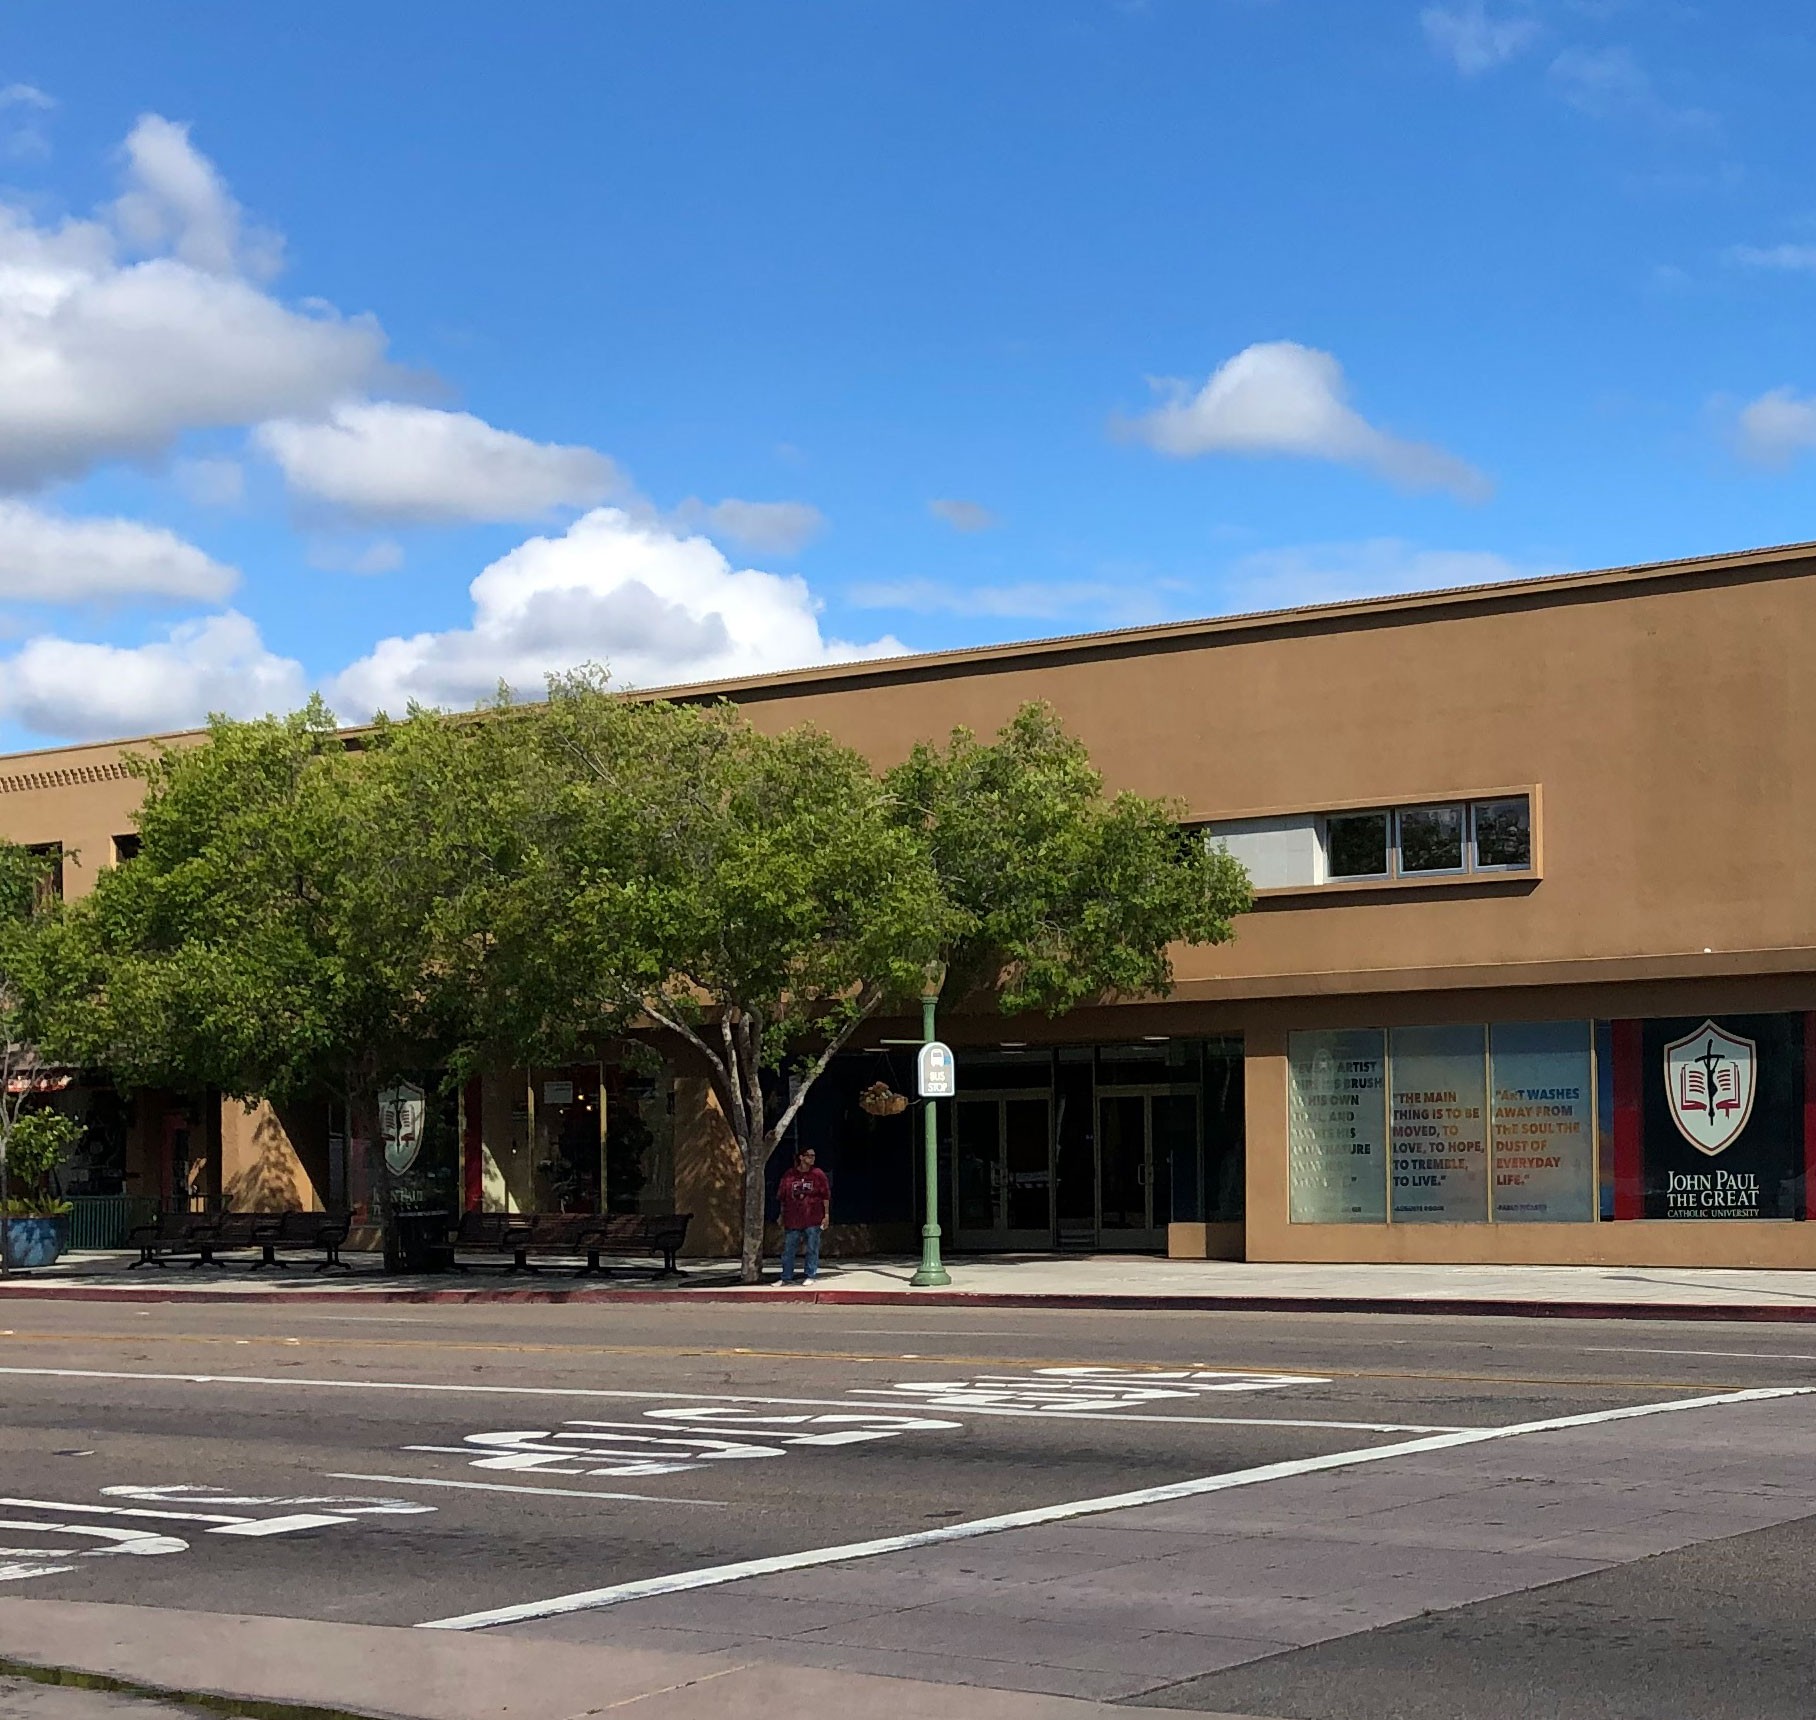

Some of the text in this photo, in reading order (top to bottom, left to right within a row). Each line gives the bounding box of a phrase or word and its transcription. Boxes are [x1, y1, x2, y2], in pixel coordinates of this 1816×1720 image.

[1337, 1061, 1377, 1073] ARTIST
[930, 1071, 946, 1082] BUS
[927, 1082, 948, 1092] STOP
[1343, 1078, 1383, 1089] BRUSH
[1308, 1095, 1327, 1105] HIS
[1330, 1095, 1360, 1105] OWN
[1393, 1091, 1456, 1103] "THE MAIN
[1527, 1088, 1580, 1100] WASHES
[1329, 1112, 1355, 1122] AND
[1393, 1108, 1480, 1120] THING IS TO BE
[1495, 1106, 1573, 1118] AWAY FROM
[1393, 1125, 1459, 1137] MOVED, TO
[1495, 1122, 1580, 1135] THE SOUL THE
[1393, 1141, 1485, 1154] LOVE, TO HOPE,
[1496, 1140, 1547, 1152] DUST OF
[1393, 1159, 1469, 1171] TO TREMBLE,
[1496, 1157, 1561, 1168] EVERYDAY
[1393, 1175, 1446, 1187] TO LIVE."
[1667, 1170, 1760, 1193] JOHN PAUL
[1666, 1190, 1760, 1207] THE GREAT
[1667, 1208, 1760, 1218] CATHOLIC UNIVERSITY
[401, 1407, 964, 1476] STOP
